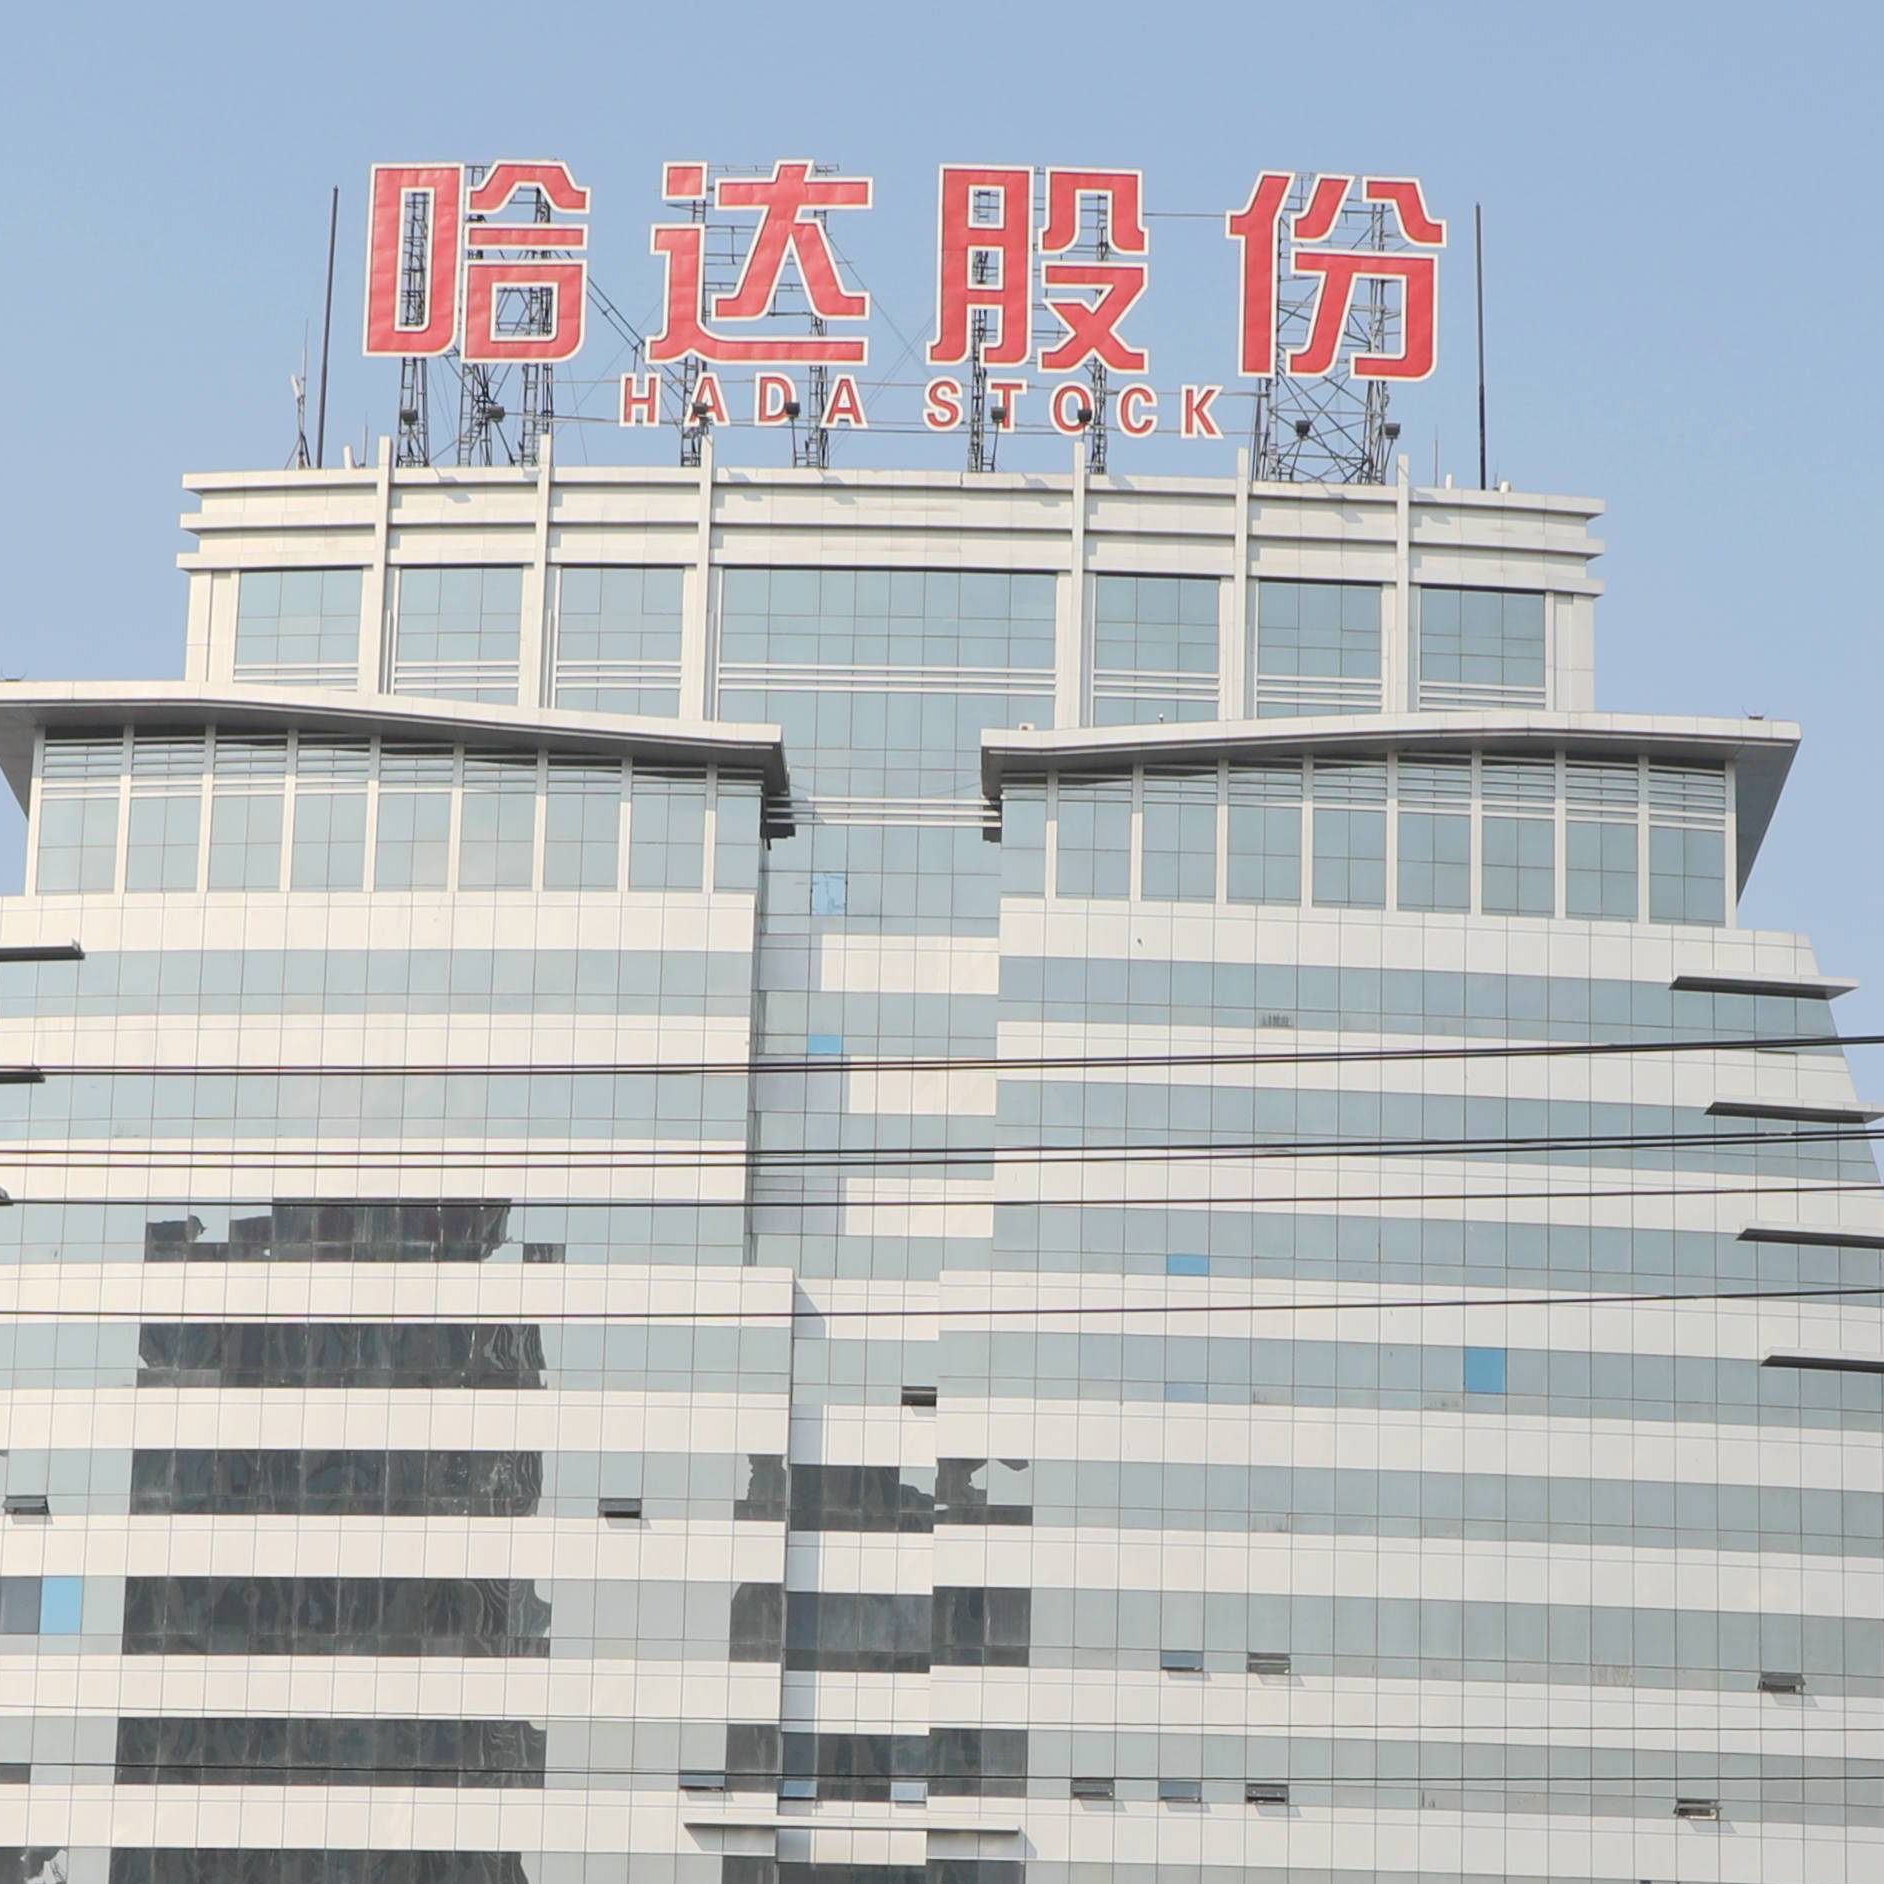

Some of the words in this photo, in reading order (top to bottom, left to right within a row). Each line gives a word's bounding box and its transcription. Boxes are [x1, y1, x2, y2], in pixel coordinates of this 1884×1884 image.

[362, 160, 1448, 380] 哈达股份
[618, 372, 868, 428] HADA
[923, 376, 1224, 440] STOCK
